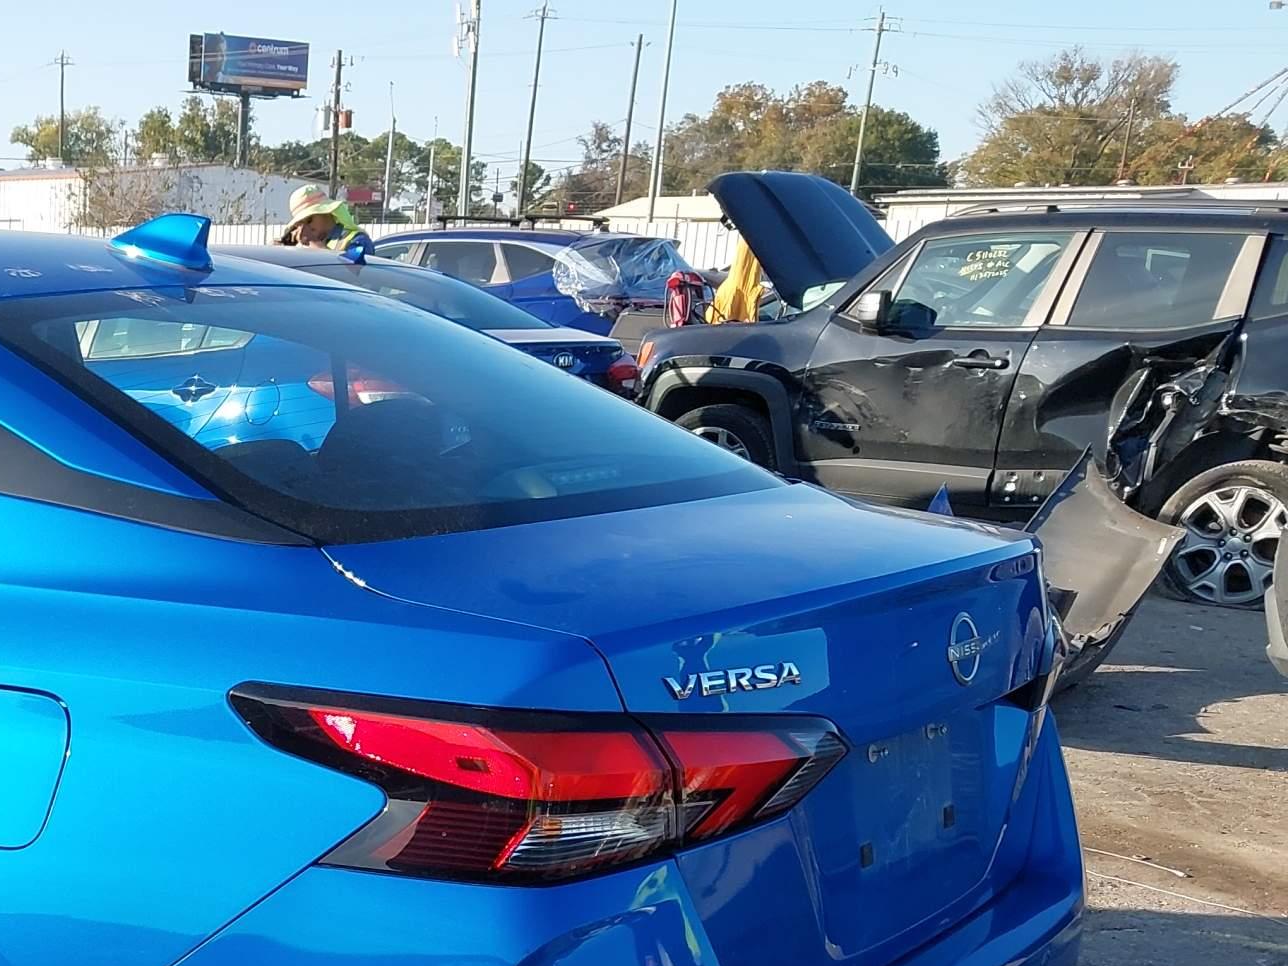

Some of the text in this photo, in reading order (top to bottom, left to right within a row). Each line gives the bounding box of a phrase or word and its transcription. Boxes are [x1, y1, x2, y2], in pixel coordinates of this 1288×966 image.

[257, 44, 289, 56] centrum
[559, 355, 573, 367] KIA
[949, 640, 983, 659] NISS
[664, 662, 801, 700] VERSA
